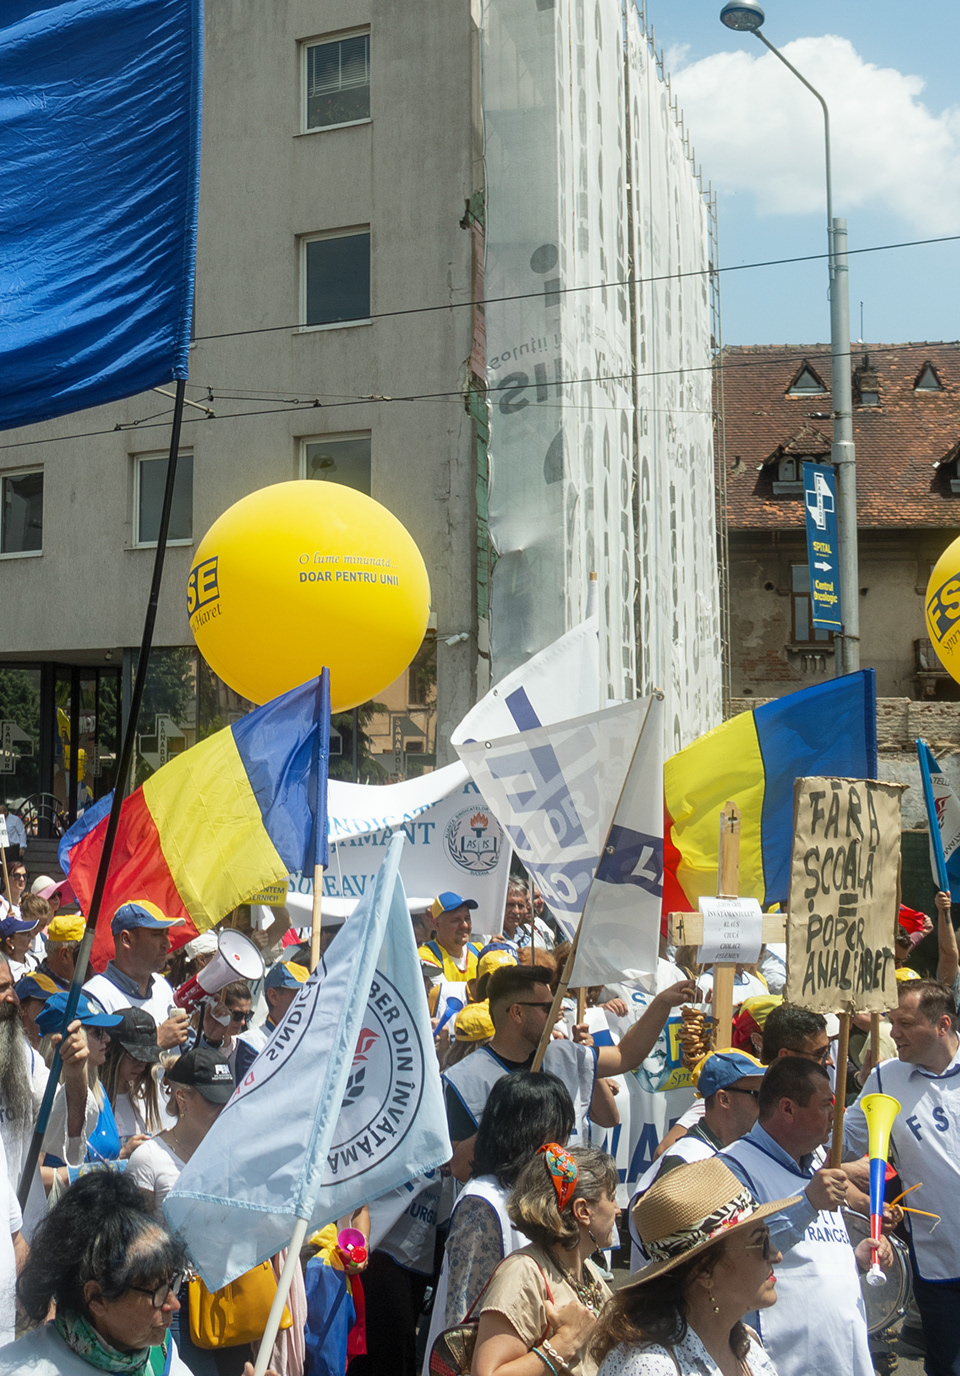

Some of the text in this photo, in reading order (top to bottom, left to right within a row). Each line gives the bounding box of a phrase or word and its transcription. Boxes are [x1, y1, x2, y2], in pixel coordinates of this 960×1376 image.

[298, 553, 310, 565] O
[313, 552, 341, 564] lume
[813, 541, 832, 554] SPITAL
[187, 560, 219, 613] SE
[299, 571, 399, 586] DOAR PENTRU UNII
[809, 782, 881, 847] FĂRĂ
[467, 839, 490, 849] AS IS
[803, 837, 878, 912] ȘCOALĂ
[327, 980, 415, 1175] BER DIN ÎNVĂȚĂMÂ
